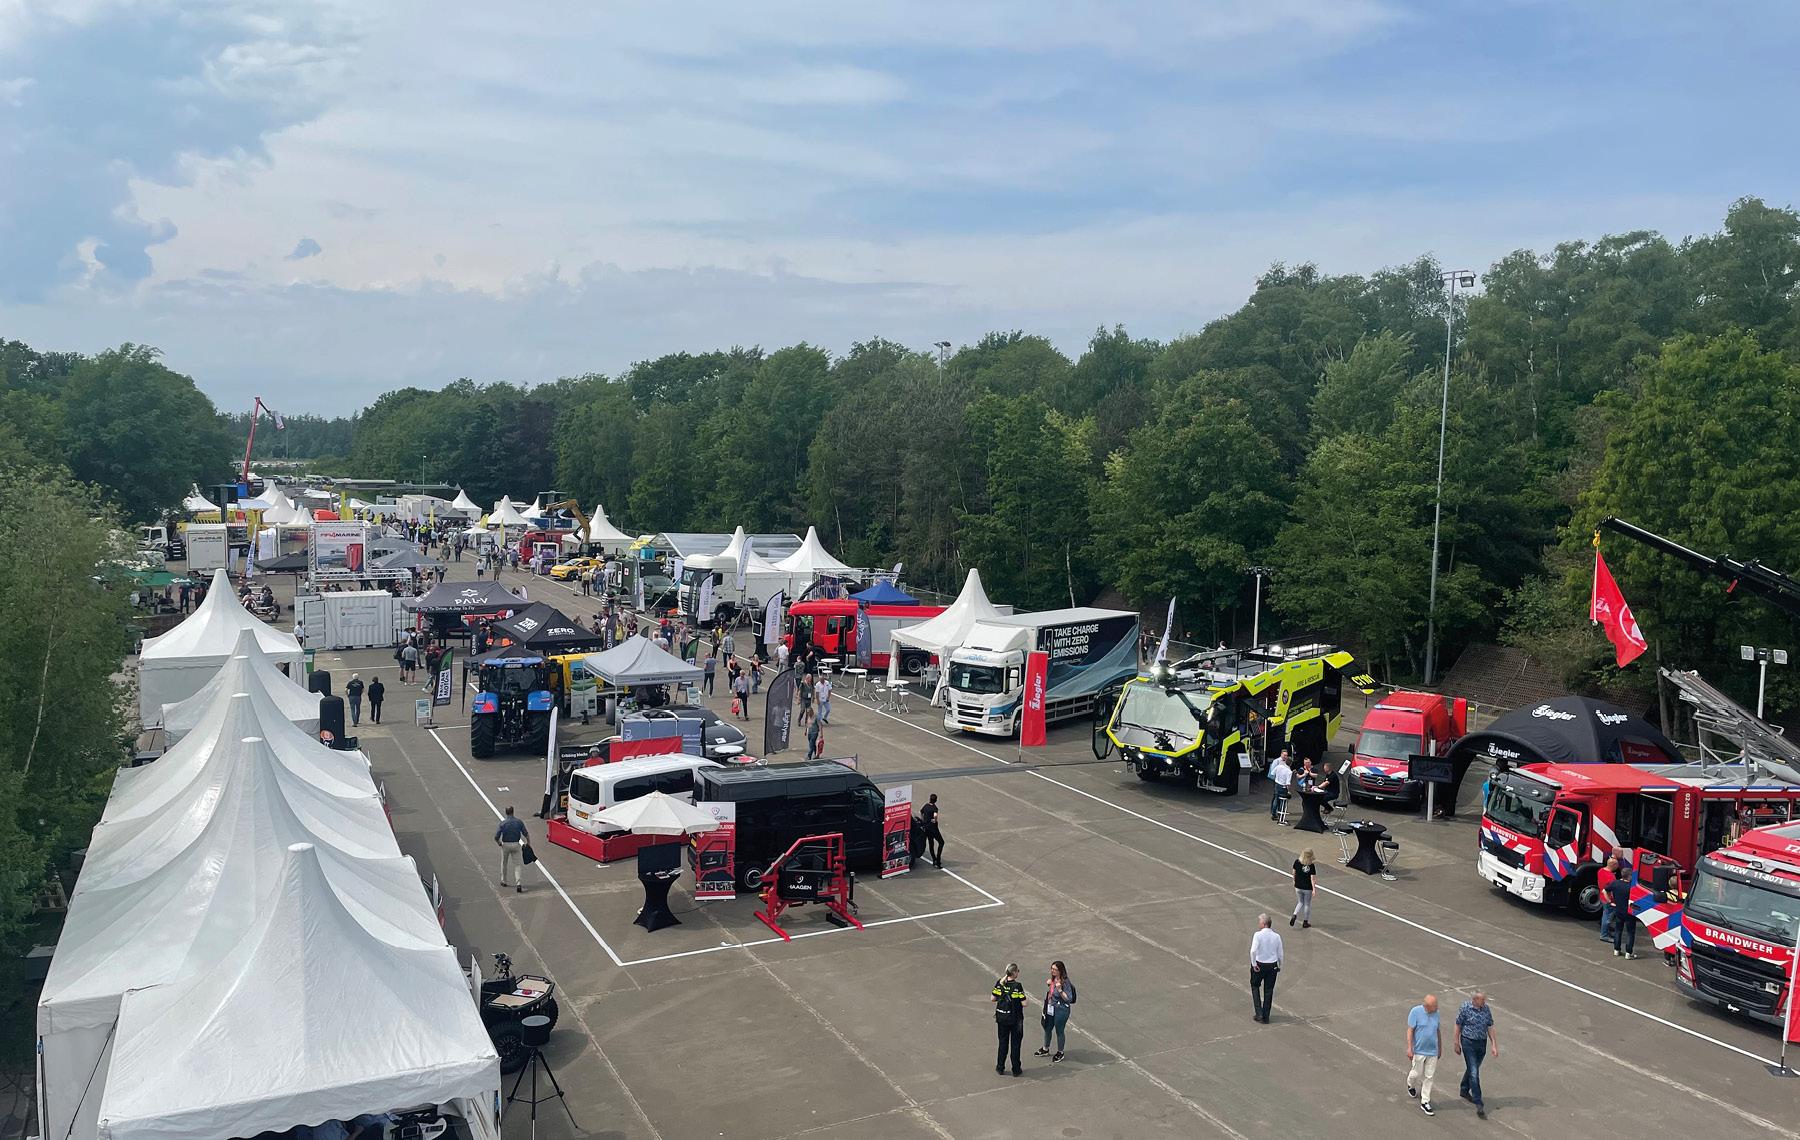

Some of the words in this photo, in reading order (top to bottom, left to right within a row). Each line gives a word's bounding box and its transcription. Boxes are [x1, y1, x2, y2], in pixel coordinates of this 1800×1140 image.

[1054, 627, 1072, 638] TAKE
[1072, 623, 1099, 635] CHARGE
[1054, 637, 1071, 648] WITH
[1071, 635, 1089, 645] ZERO
[1053, 644, 1089, 658] EMISSIONS
[1029, 672, 1042, 711] Ziegler
[1532, 705, 1577, 720] Ziegler
[1595, 709, 1628, 726] Ziegler
[781, 709, 791, 742] Lightyear
[1487, 743, 1520, 759] Ziegler
[1490, 825, 1518, 842] BRANDWEER
[1724, 864, 1749, 875] VRZW
[1754, 871, 1784, 885] 11-8071
[1705, 927, 1773, 955] BRANDWEER
